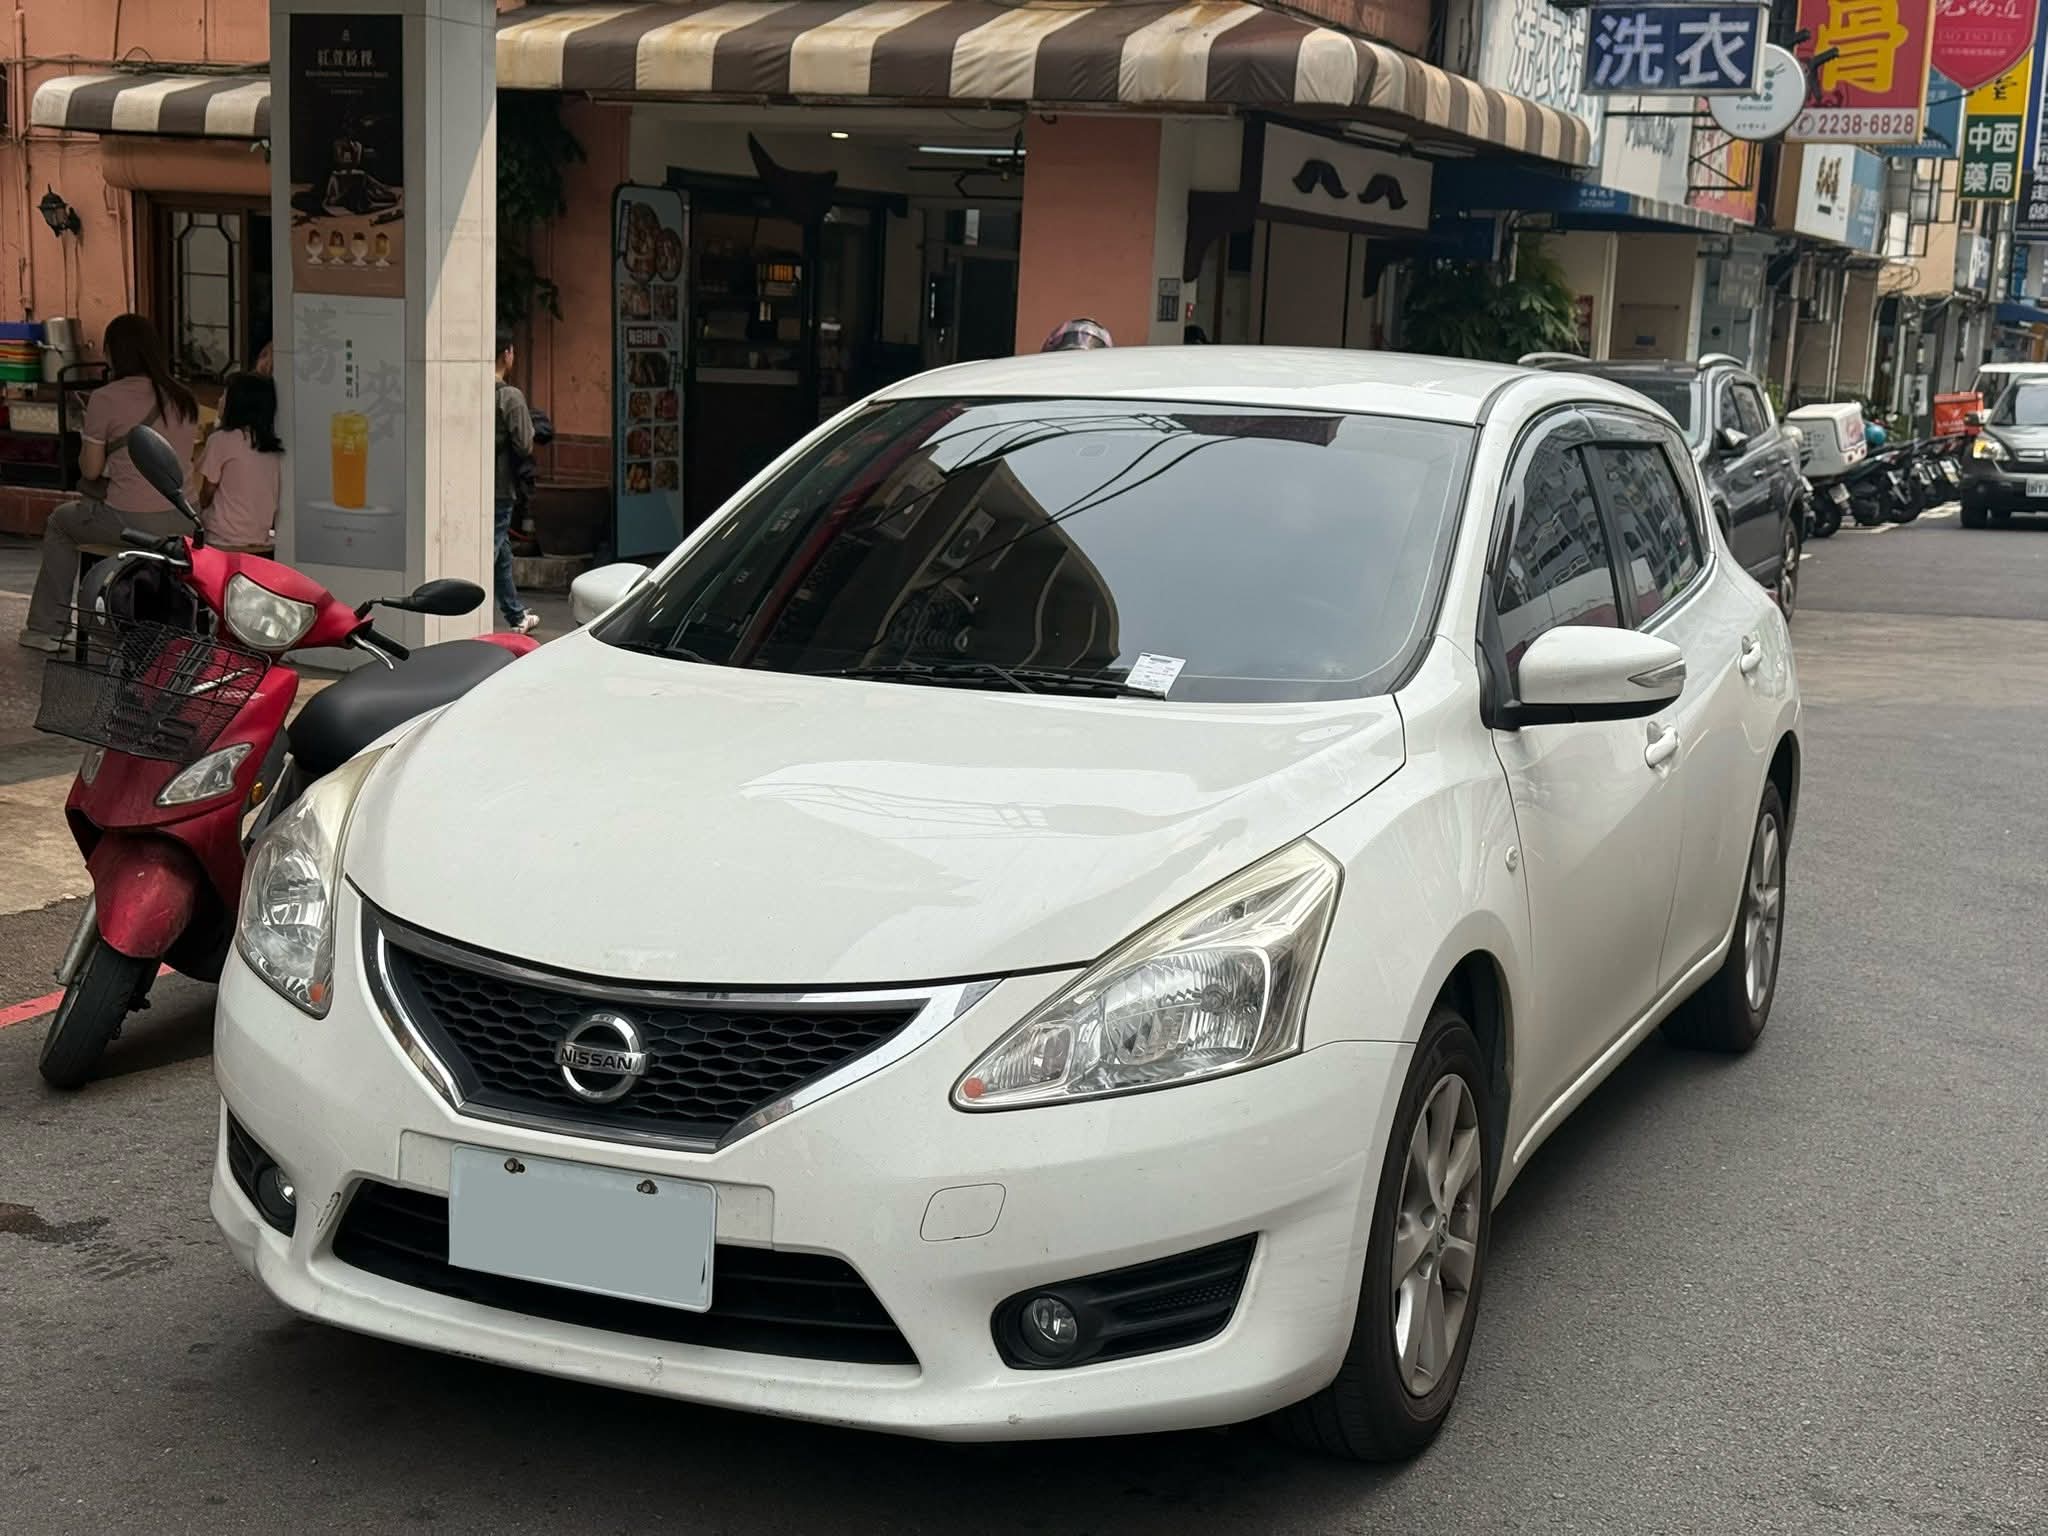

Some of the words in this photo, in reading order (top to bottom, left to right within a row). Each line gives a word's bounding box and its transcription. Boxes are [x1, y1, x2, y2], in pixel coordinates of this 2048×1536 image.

[1594, 12, 1750, 87] 洗衣
[1817, 114, 1915, 134] 2238-6828
[1967, 121, 2019, 154] 中西
[1963, 162, 2013, 193] 藥局
[561, 1048, 632, 1070] NISSAN
